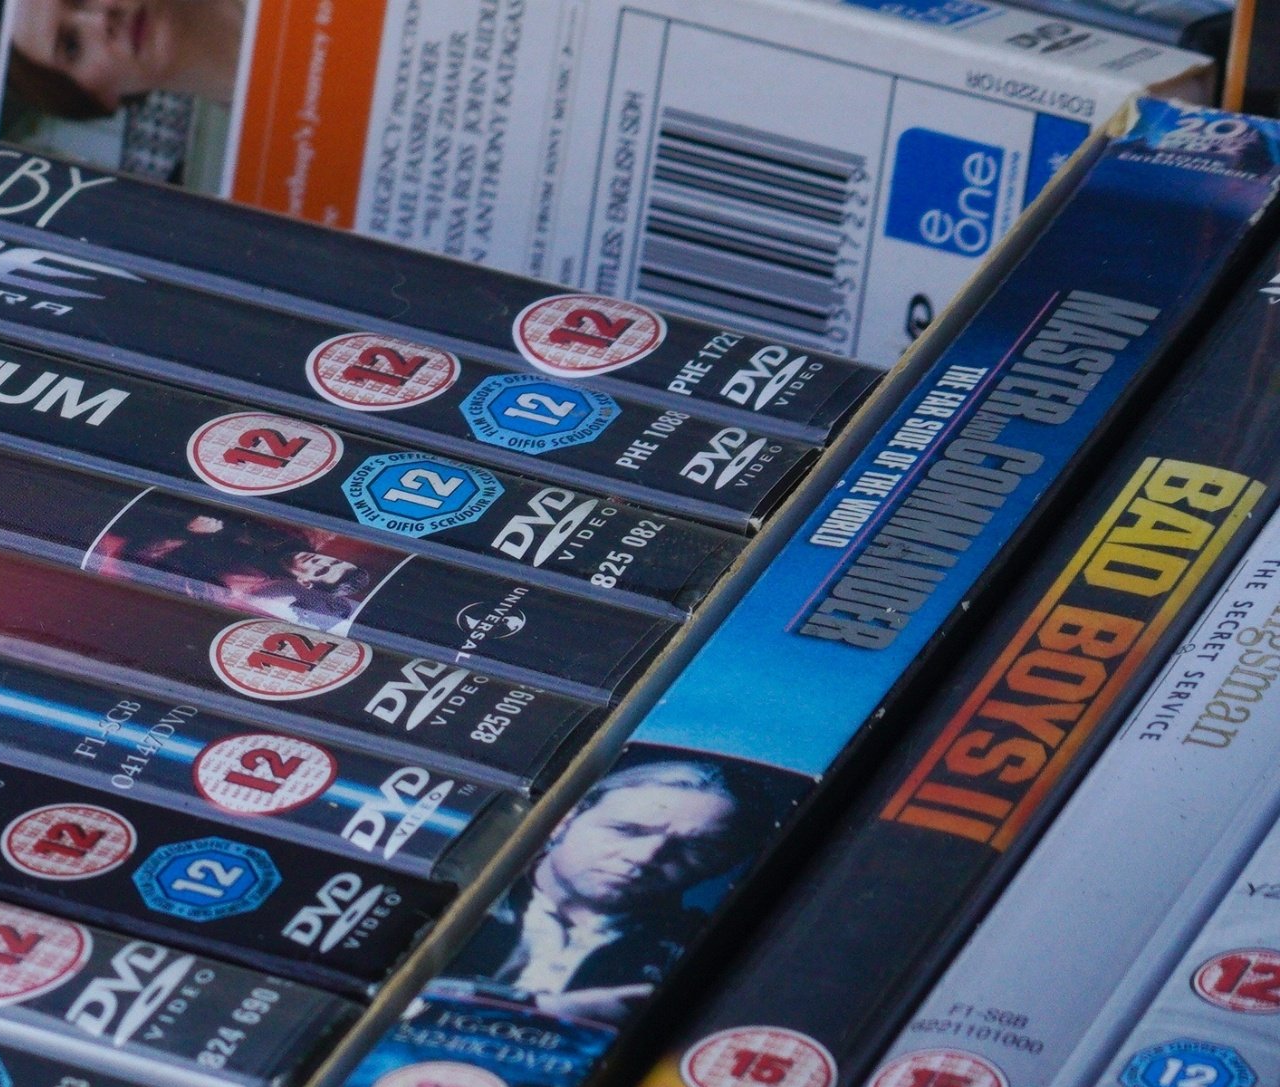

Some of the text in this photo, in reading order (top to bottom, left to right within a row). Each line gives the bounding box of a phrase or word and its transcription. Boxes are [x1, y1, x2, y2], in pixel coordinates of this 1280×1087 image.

[953, 150, 998, 253] one
[548, 307, 633, 348] 12
[340, 346, 430, 388] 12
[667, 357, 707, 397] PHE
[718, 344, 789, 406] DVD
[774, 361, 824, 407] VIDEO
[936, 364, 988, 395] THE
[996, 290, 1161, 427] MASTER
[503, 392, 577, 426] 12
[887, 411, 945, 457] SIDE
[221, 428, 312, 470] 12
[615, 432, 657, 472] PHE
[679, 426, 748, 485] DVD
[735, 443, 783, 488] VIDEO
[873, 449, 914, 475] OF
[382, 467, 465, 510] 12
[855, 467, 902, 501] THE
[490, 486, 576, 562] DVD
[556, 505, 619, 563] VIDEO
[799, 441, 1046, 651] COMMANDER
[809, 494, 881, 548] WORLD
[589, 517, 666, 590] 825 082
[453, 586, 530, 663] UNIVERSAL
[895, 456, 1250, 844] BAD BOYS II
[1197, 600, 1254, 663] SECRET
[246, 632, 339, 675] 12
[363, 656, 448, 726] DVD
[429, 673, 490, 727] VIDEO
[1139, 669, 1205, 743] SERVICE
[470, 708, 508, 746] 825
[223, 746, 306, 793] 12
[339, 766, 431, 852] DVD
[31, 821, 105, 859] 12
[171, 858, 245, 898] 12
[280, 871, 363, 949] DVD
[343, 891, 403, 950] VIDEO
[64, 938, 169, 1039] DVD
[142, 967, 218, 1043] VIDEO
[728, 1049, 795, 1086] 15
